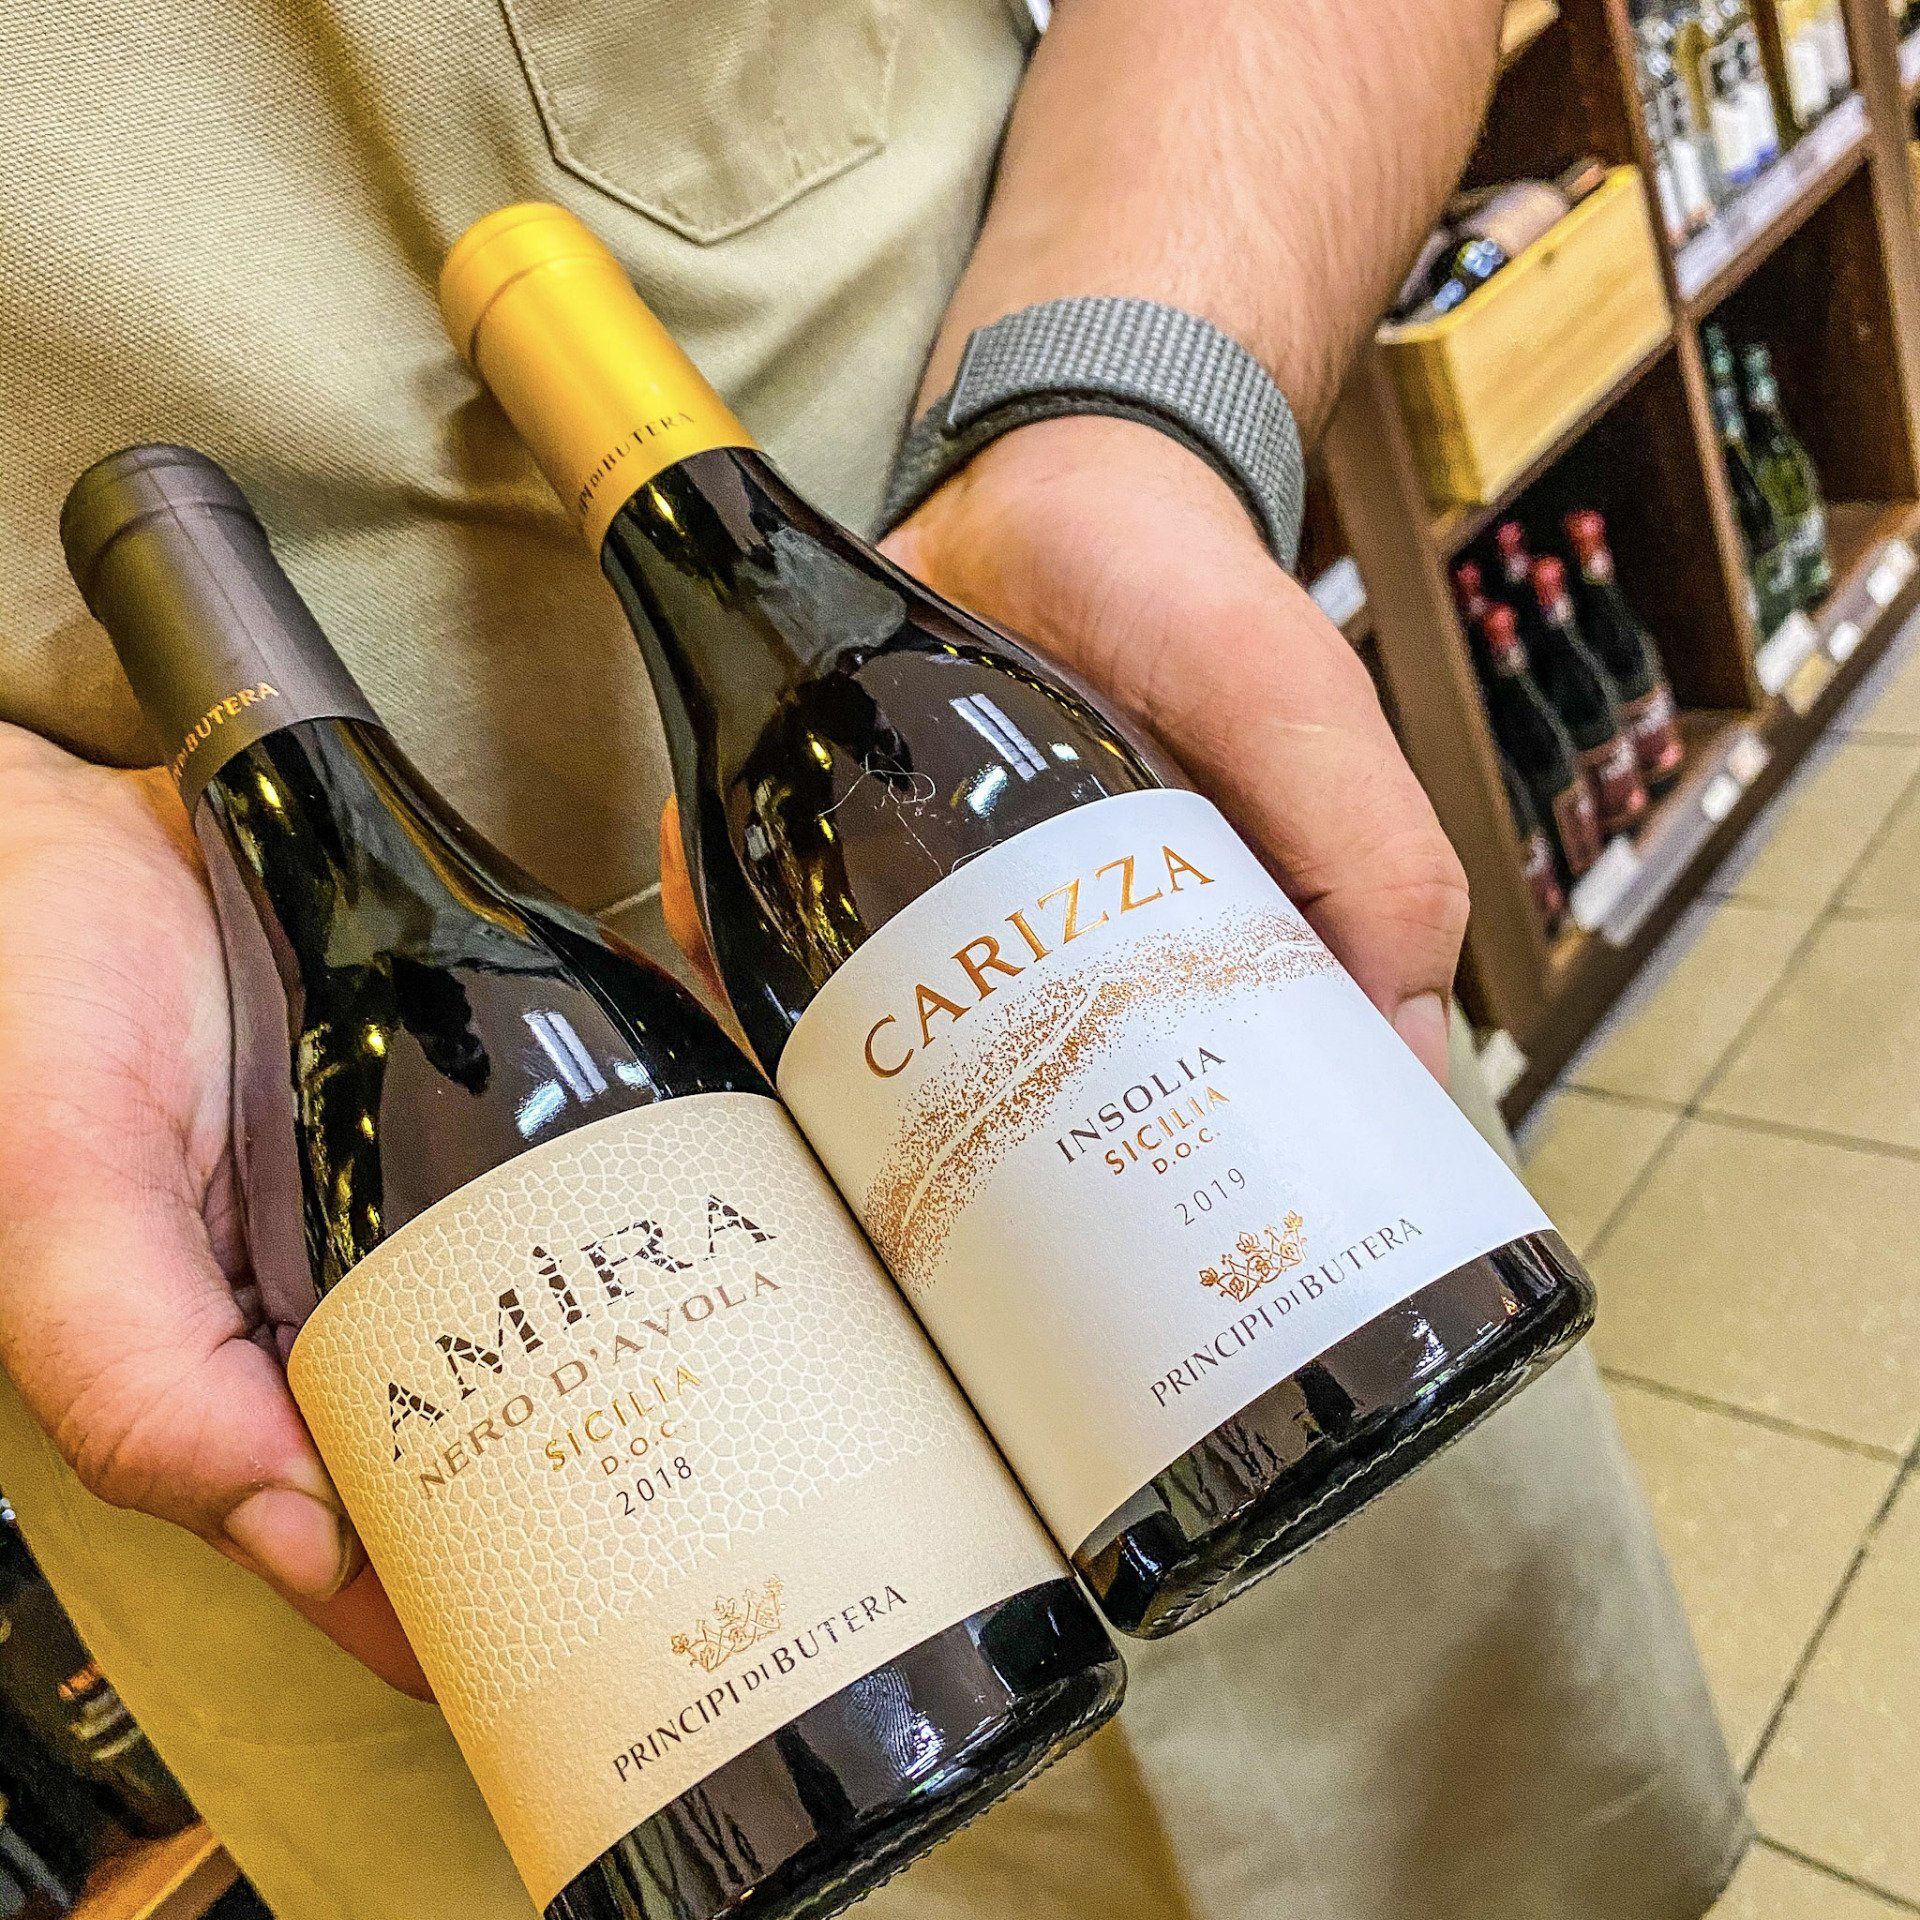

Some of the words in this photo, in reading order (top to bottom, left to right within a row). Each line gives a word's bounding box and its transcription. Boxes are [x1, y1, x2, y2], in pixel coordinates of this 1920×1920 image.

[602, 412, 695, 471] BUTERA
[184, 681, 280, 753] BUTERA
[864, 845, 1215, 1079] CARIZZA
[1055, 1046, 1226, 1164] INSOLIA
[1104, 1086, 1230, 1175] SICILIA
[1151, 1127, 1221, 1175] D.O.C.
[1174, 1167, 1246, 1226] 2019
[388, 1194, 777, 1462] AMIRA
[1150, 1304, 1276, 1407] PRINCIPI
[1274, 1289, 1303, 1316] DI
[1299, 1217, 1423, 1300] BUTERA
[418, 1394, 534, 1500] NERO
[549, 1271, 782, 1397] D'AVOLA
[545, 1365, 701, 1472] SICILIA
[616, 1456, 692, 1516] 2018
[612, 1680, 741, 1782] PRINCIPI
[741, 1663, 772, 1692] DI
[770, 1584, 908, 1675] BUTERA
